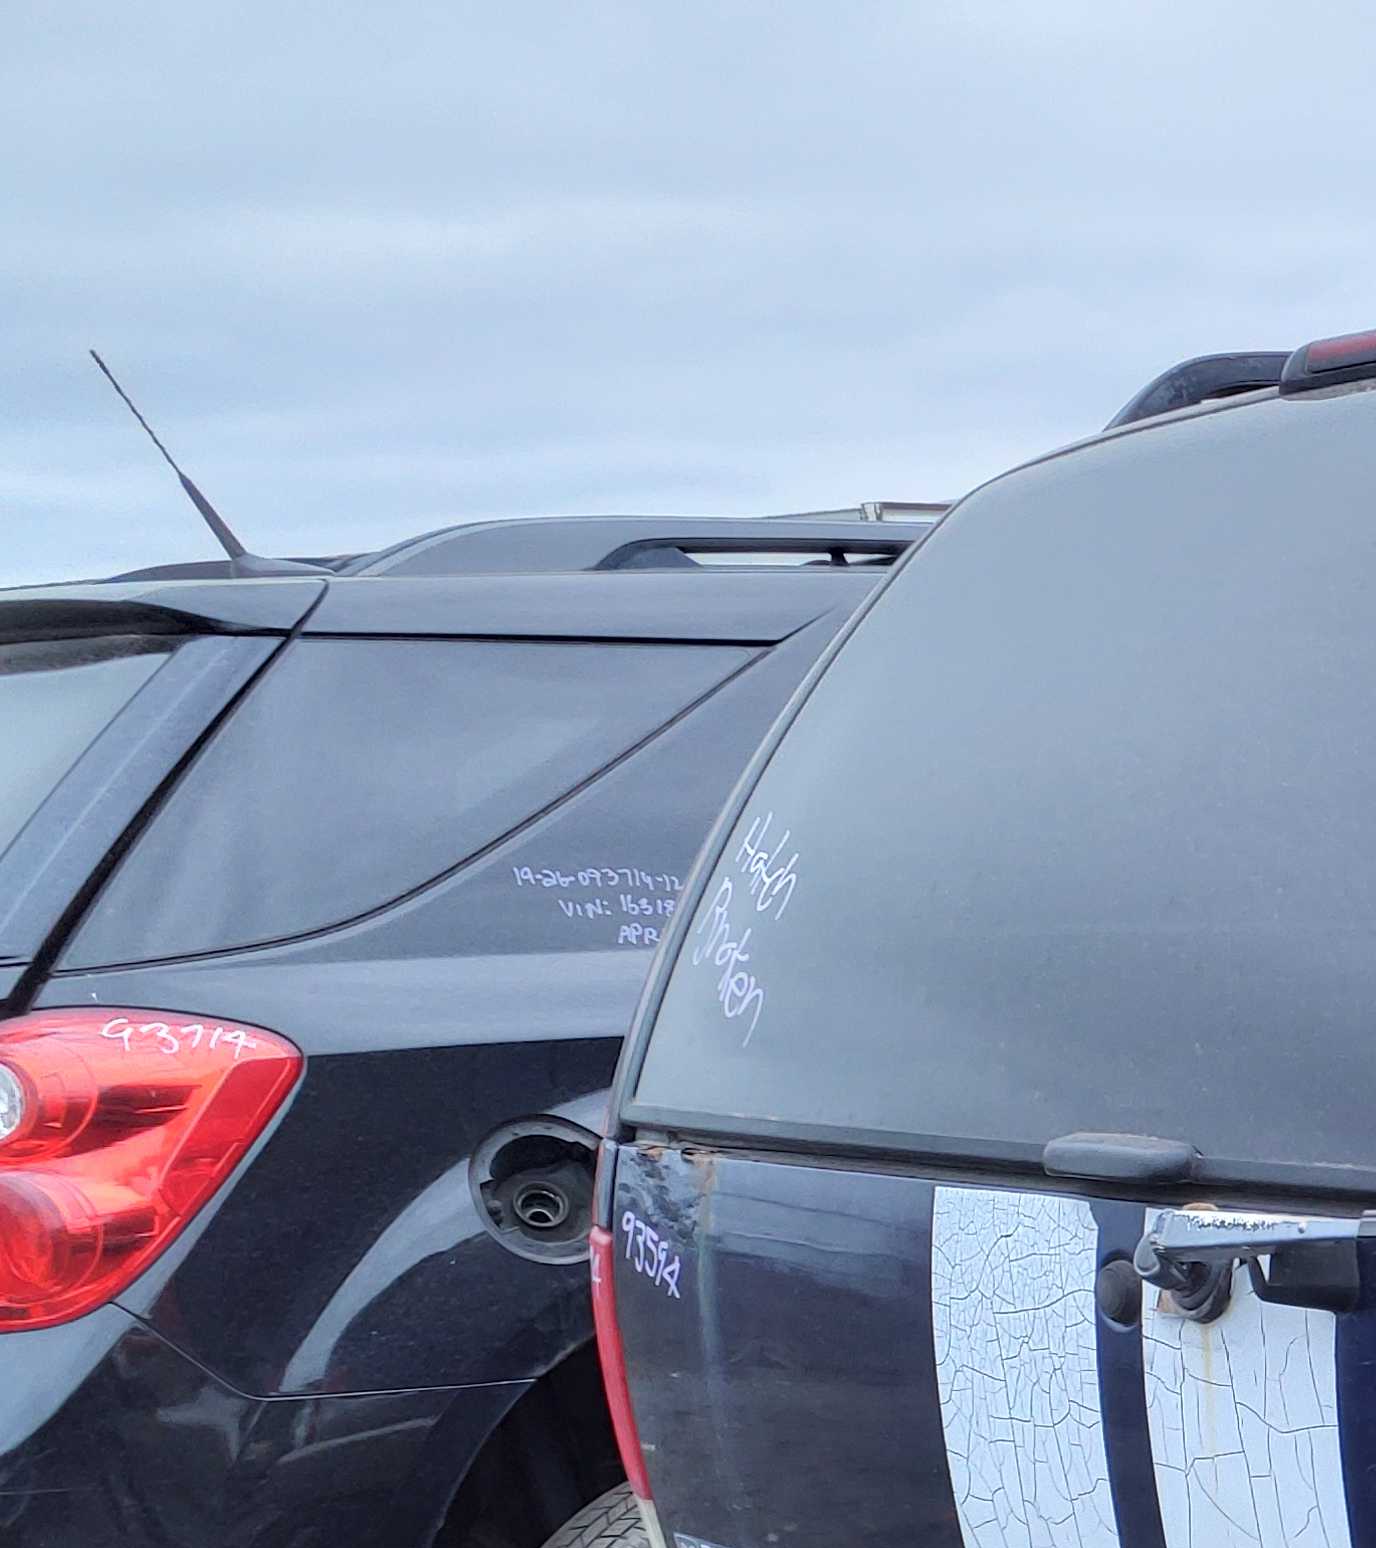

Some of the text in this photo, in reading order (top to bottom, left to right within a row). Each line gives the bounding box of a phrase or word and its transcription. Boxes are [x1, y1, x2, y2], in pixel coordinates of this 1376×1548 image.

[618, 922, 661, 945] APR
[101, 1018, 257, 1059] 93714
[622, 1211, 681, 1299] 93594
